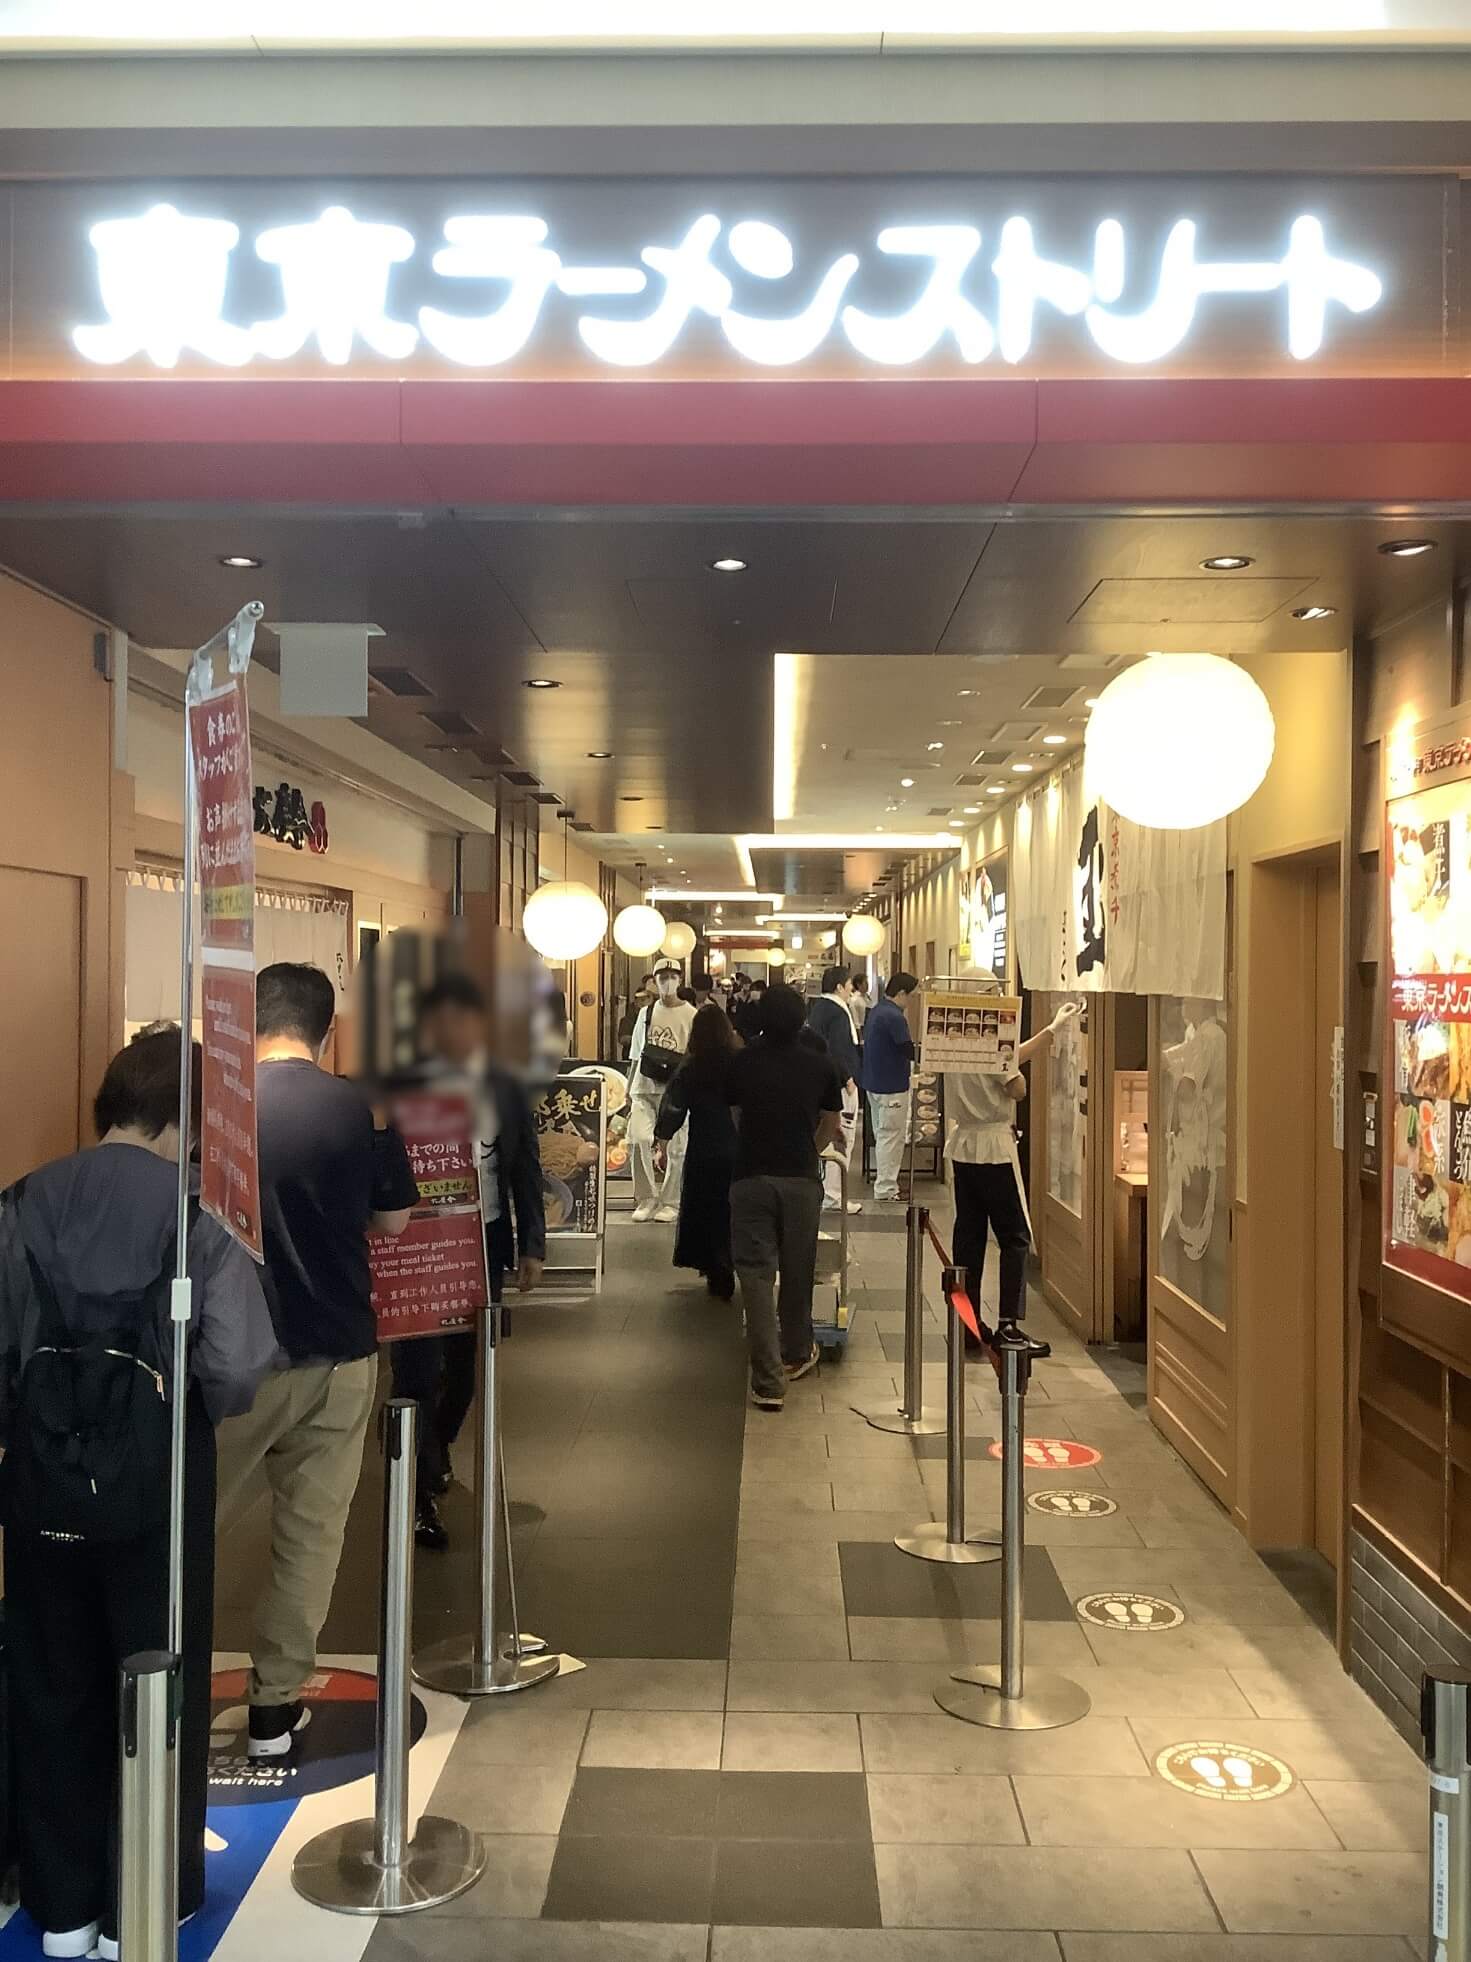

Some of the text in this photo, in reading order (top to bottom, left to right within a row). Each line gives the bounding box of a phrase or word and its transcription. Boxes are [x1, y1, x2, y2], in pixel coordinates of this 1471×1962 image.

[72, 201, 1386, 368] 東京ラーメンストリート
[378, 1246, 396, 1255] staff
[397, 1242, 430, 1253] member
[431, 1239, 456, 1251] guides
[380, 1260, 399, 1270] your
[401, 1255, 420, 1266] meal
[422, 1253, 445, 1263] ticket
[376, 1269, 399, 1279] when
[400, 1267, 413, 1276] the
[414, 1264, 432, 1275] staff
[434, 1262, 460, 1274] guides
[208, 1776, 284, 1788] wait here
